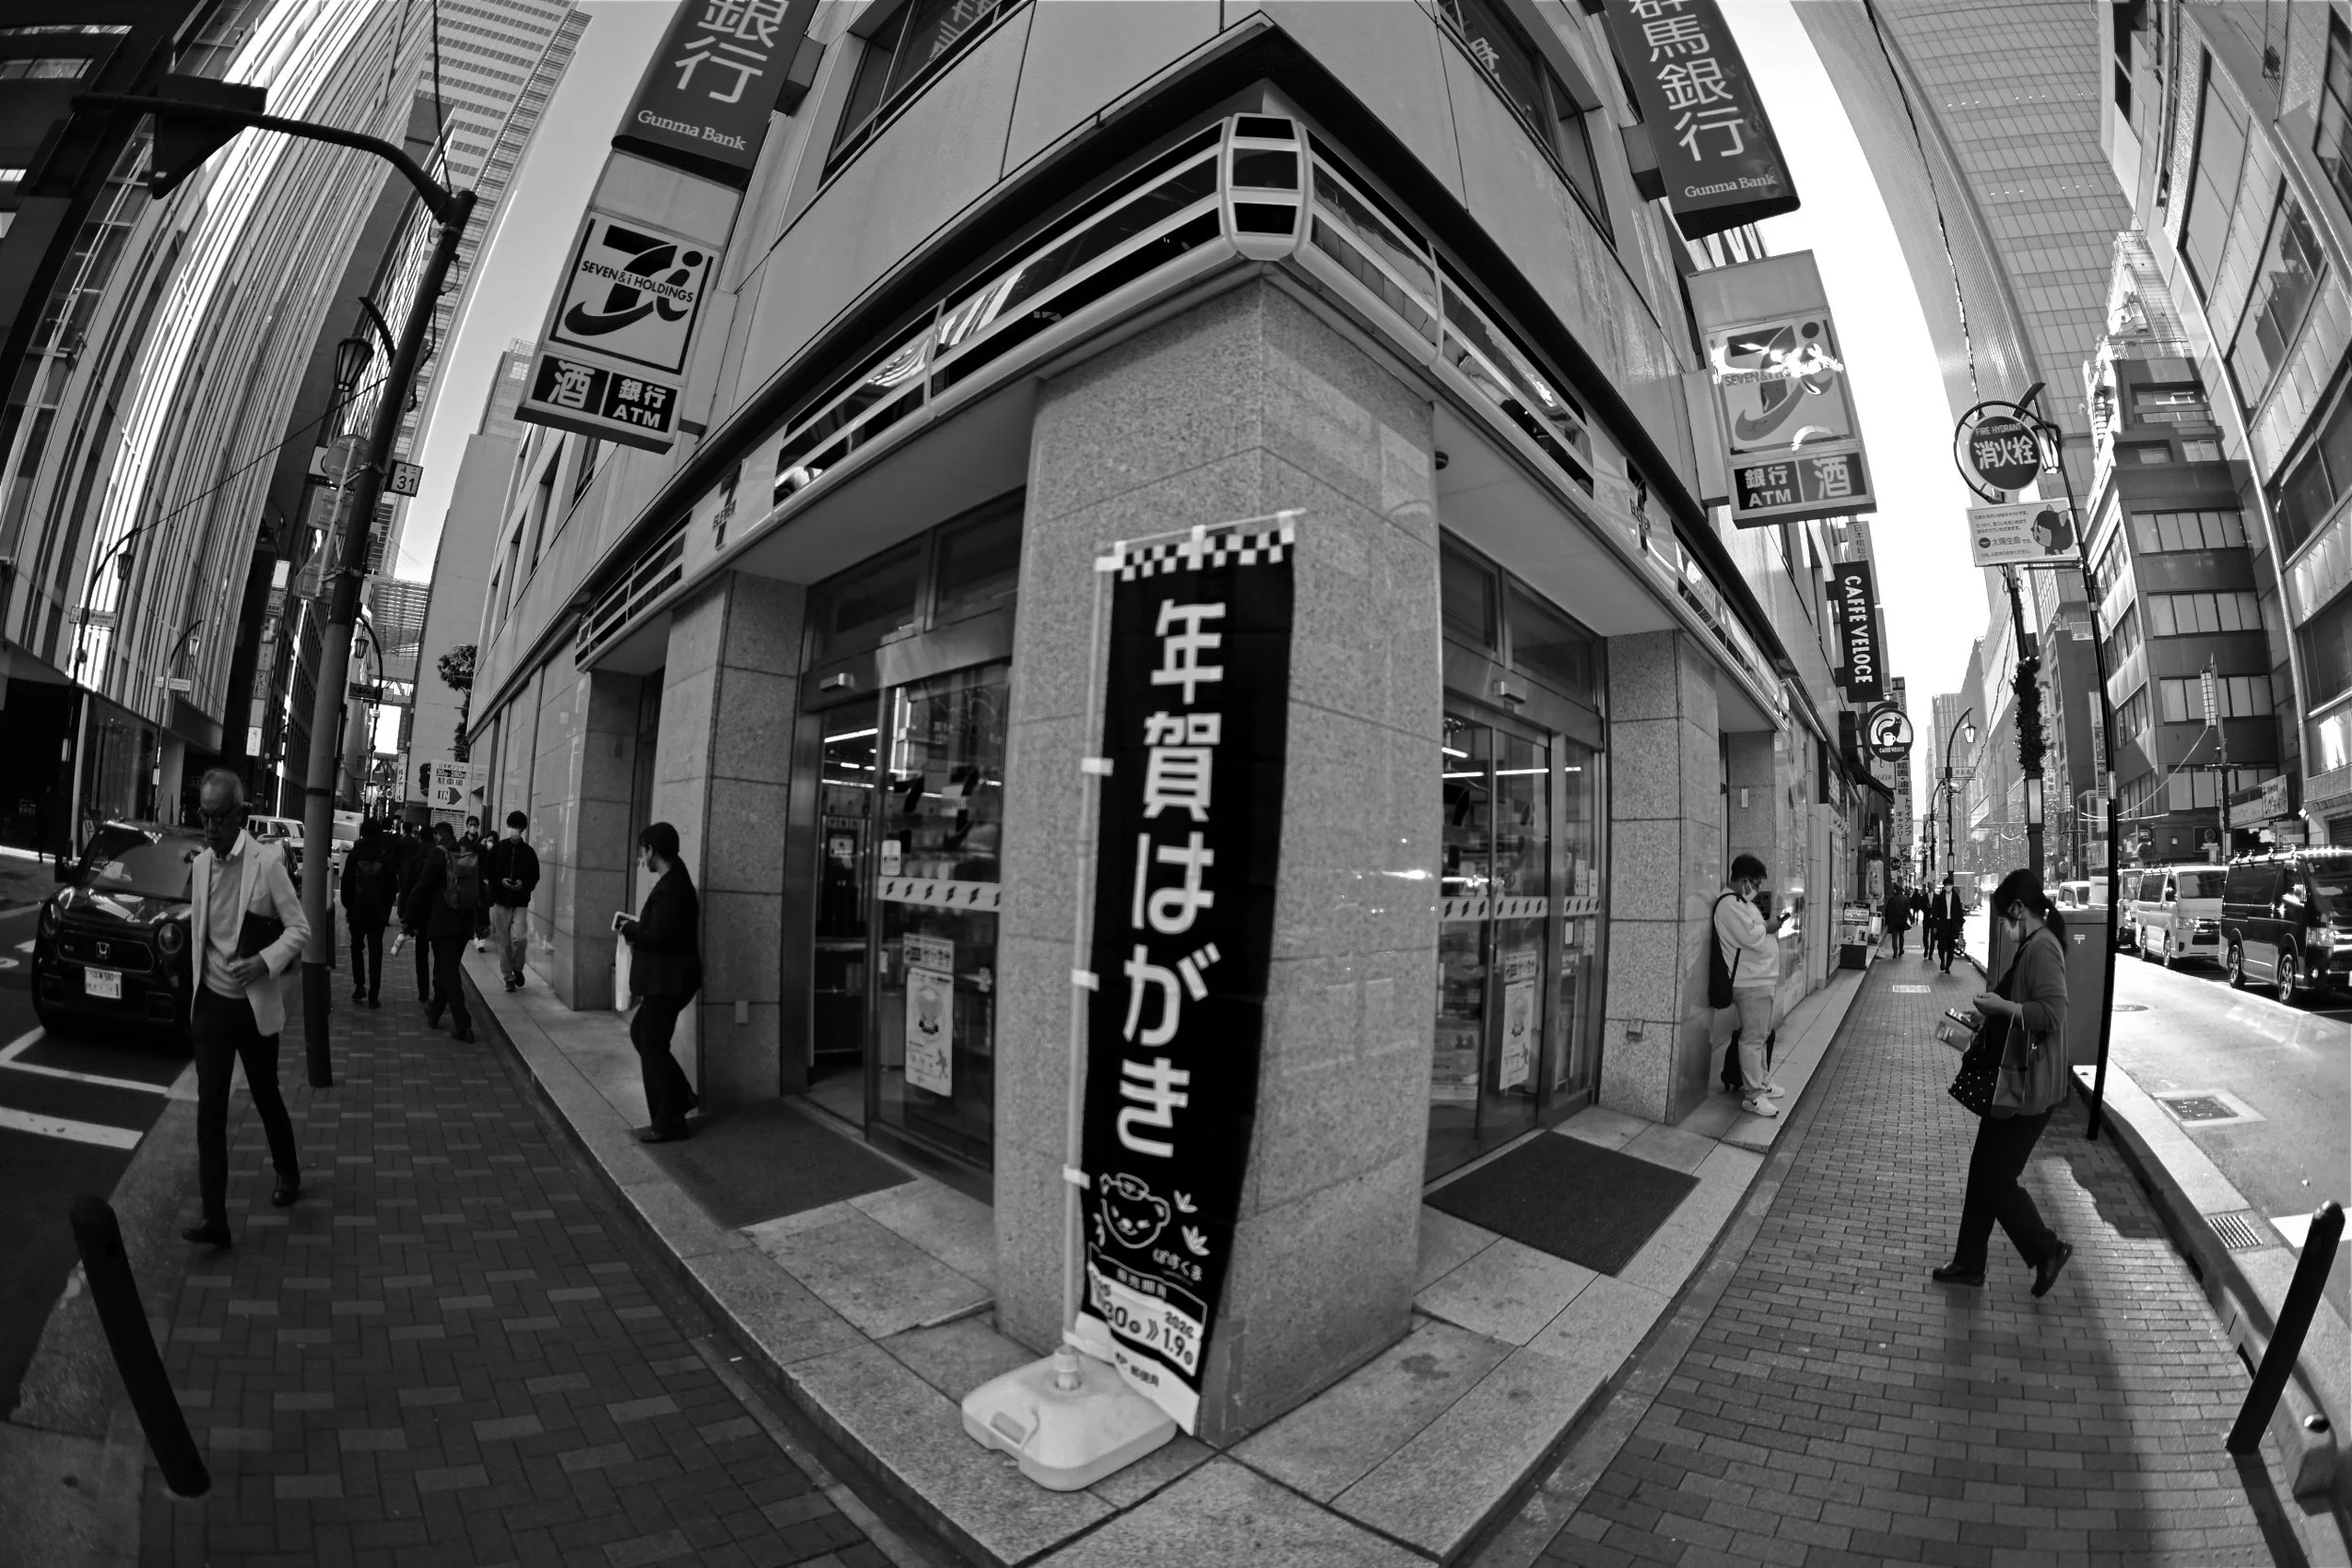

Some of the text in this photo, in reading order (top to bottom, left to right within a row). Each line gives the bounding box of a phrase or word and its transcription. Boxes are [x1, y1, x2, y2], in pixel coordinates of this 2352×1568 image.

[675, 0, 789, 103] 銀行
[637, 109, 747, 151] Gunma Bank
[1684, 173, 1777, 199] Gunma Bank
[633, 275, 694, 303] HOLDINGS
[548, 359, 596, 410] 酒
[616, 377, 667, 410] 銀行
[612, 403, 662, 429] ATM
[1976, 422, 2022, 436] FIRE HYDRANT
[1974, 435, 2038, 469] 消火栓
[396, 475, 415, 492] 31
[1744, 465, 1788, 491] 銀行
[1813, 457, 1849, 500] 酒
[1748, 484, 1792, 508] ATM
[1850, 624, 1873, 684] VELOCE
[437, 790, 451, 800] IN
[1116, 599, 1225, 1159] 年賀はがき
